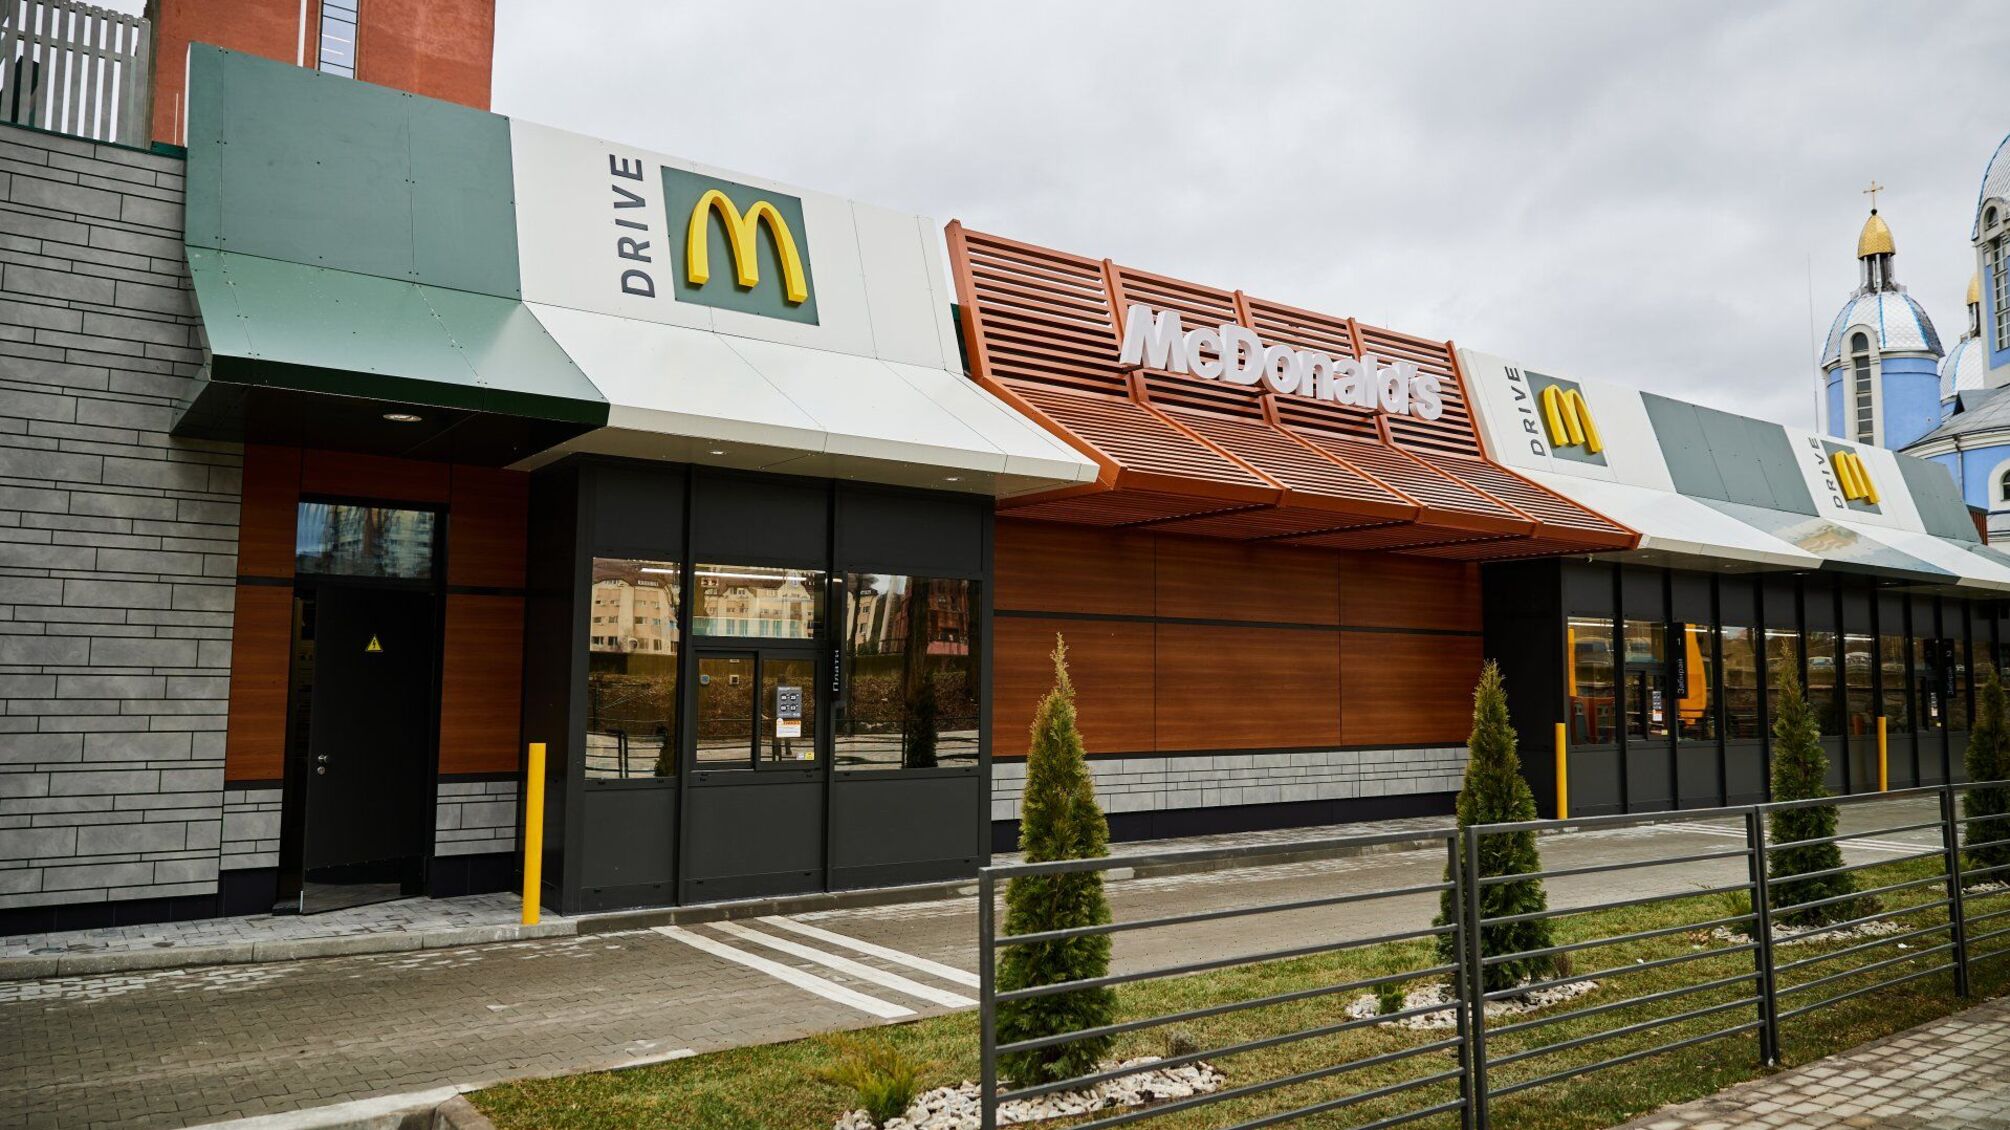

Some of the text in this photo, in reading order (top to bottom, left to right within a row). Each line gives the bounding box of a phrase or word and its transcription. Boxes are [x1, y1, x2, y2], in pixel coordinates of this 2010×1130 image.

[609, 154, 656, 298] DRIVE
[1119, 304, 1443, 421] McDonald's
[1504, 366, 1546, 456] DRIVE
[1808, 437, 1844, 508] DRIVE
